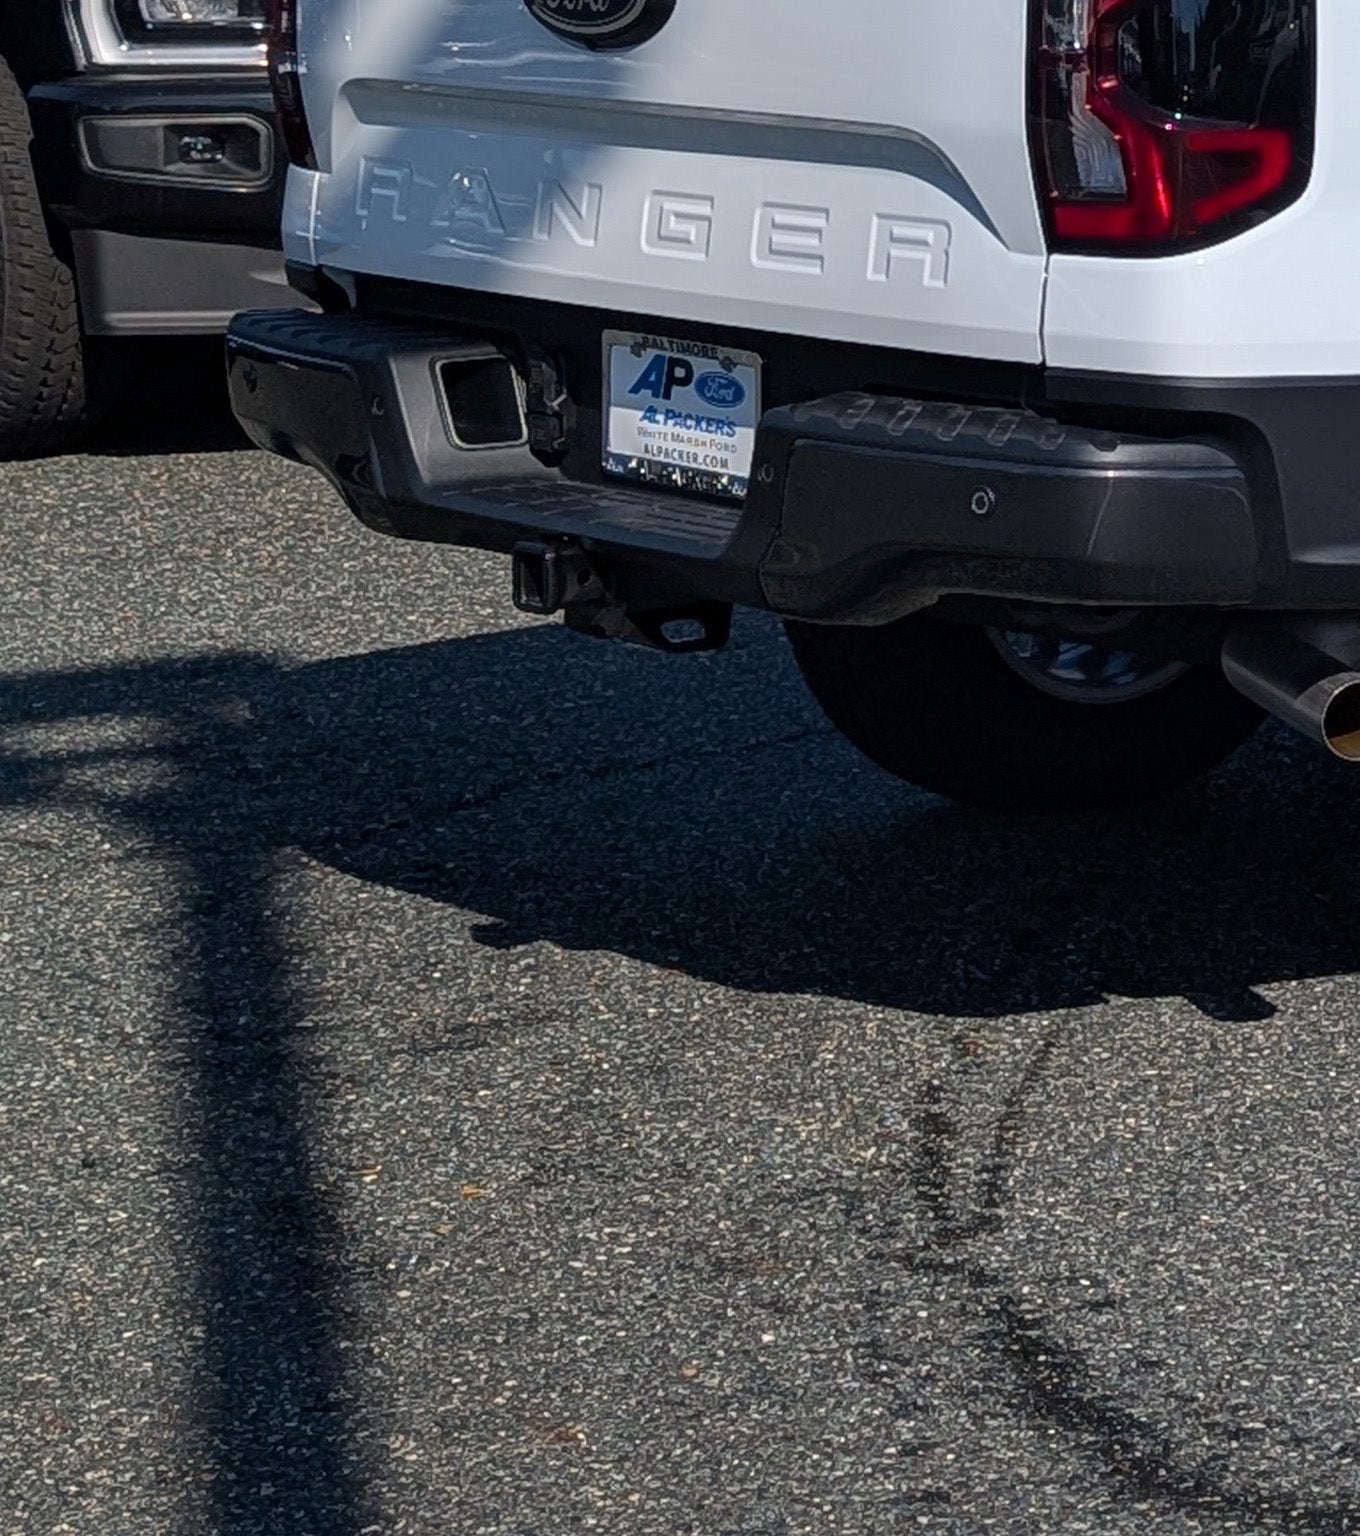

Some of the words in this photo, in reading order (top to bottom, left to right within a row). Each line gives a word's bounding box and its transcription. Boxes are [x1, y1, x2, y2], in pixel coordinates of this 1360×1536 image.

[355, 154, 953, 288] RANGER
[642, 336, 719, 359] BALTIMORE
[628, 354, 694, 401] AP
[704, 377, 736, 402] Ford
[640, 405, 661, 426] AL
[663, 409, 737, 438] PACKER'S
[644, 444, 729, 470] ALPACKER.COM
